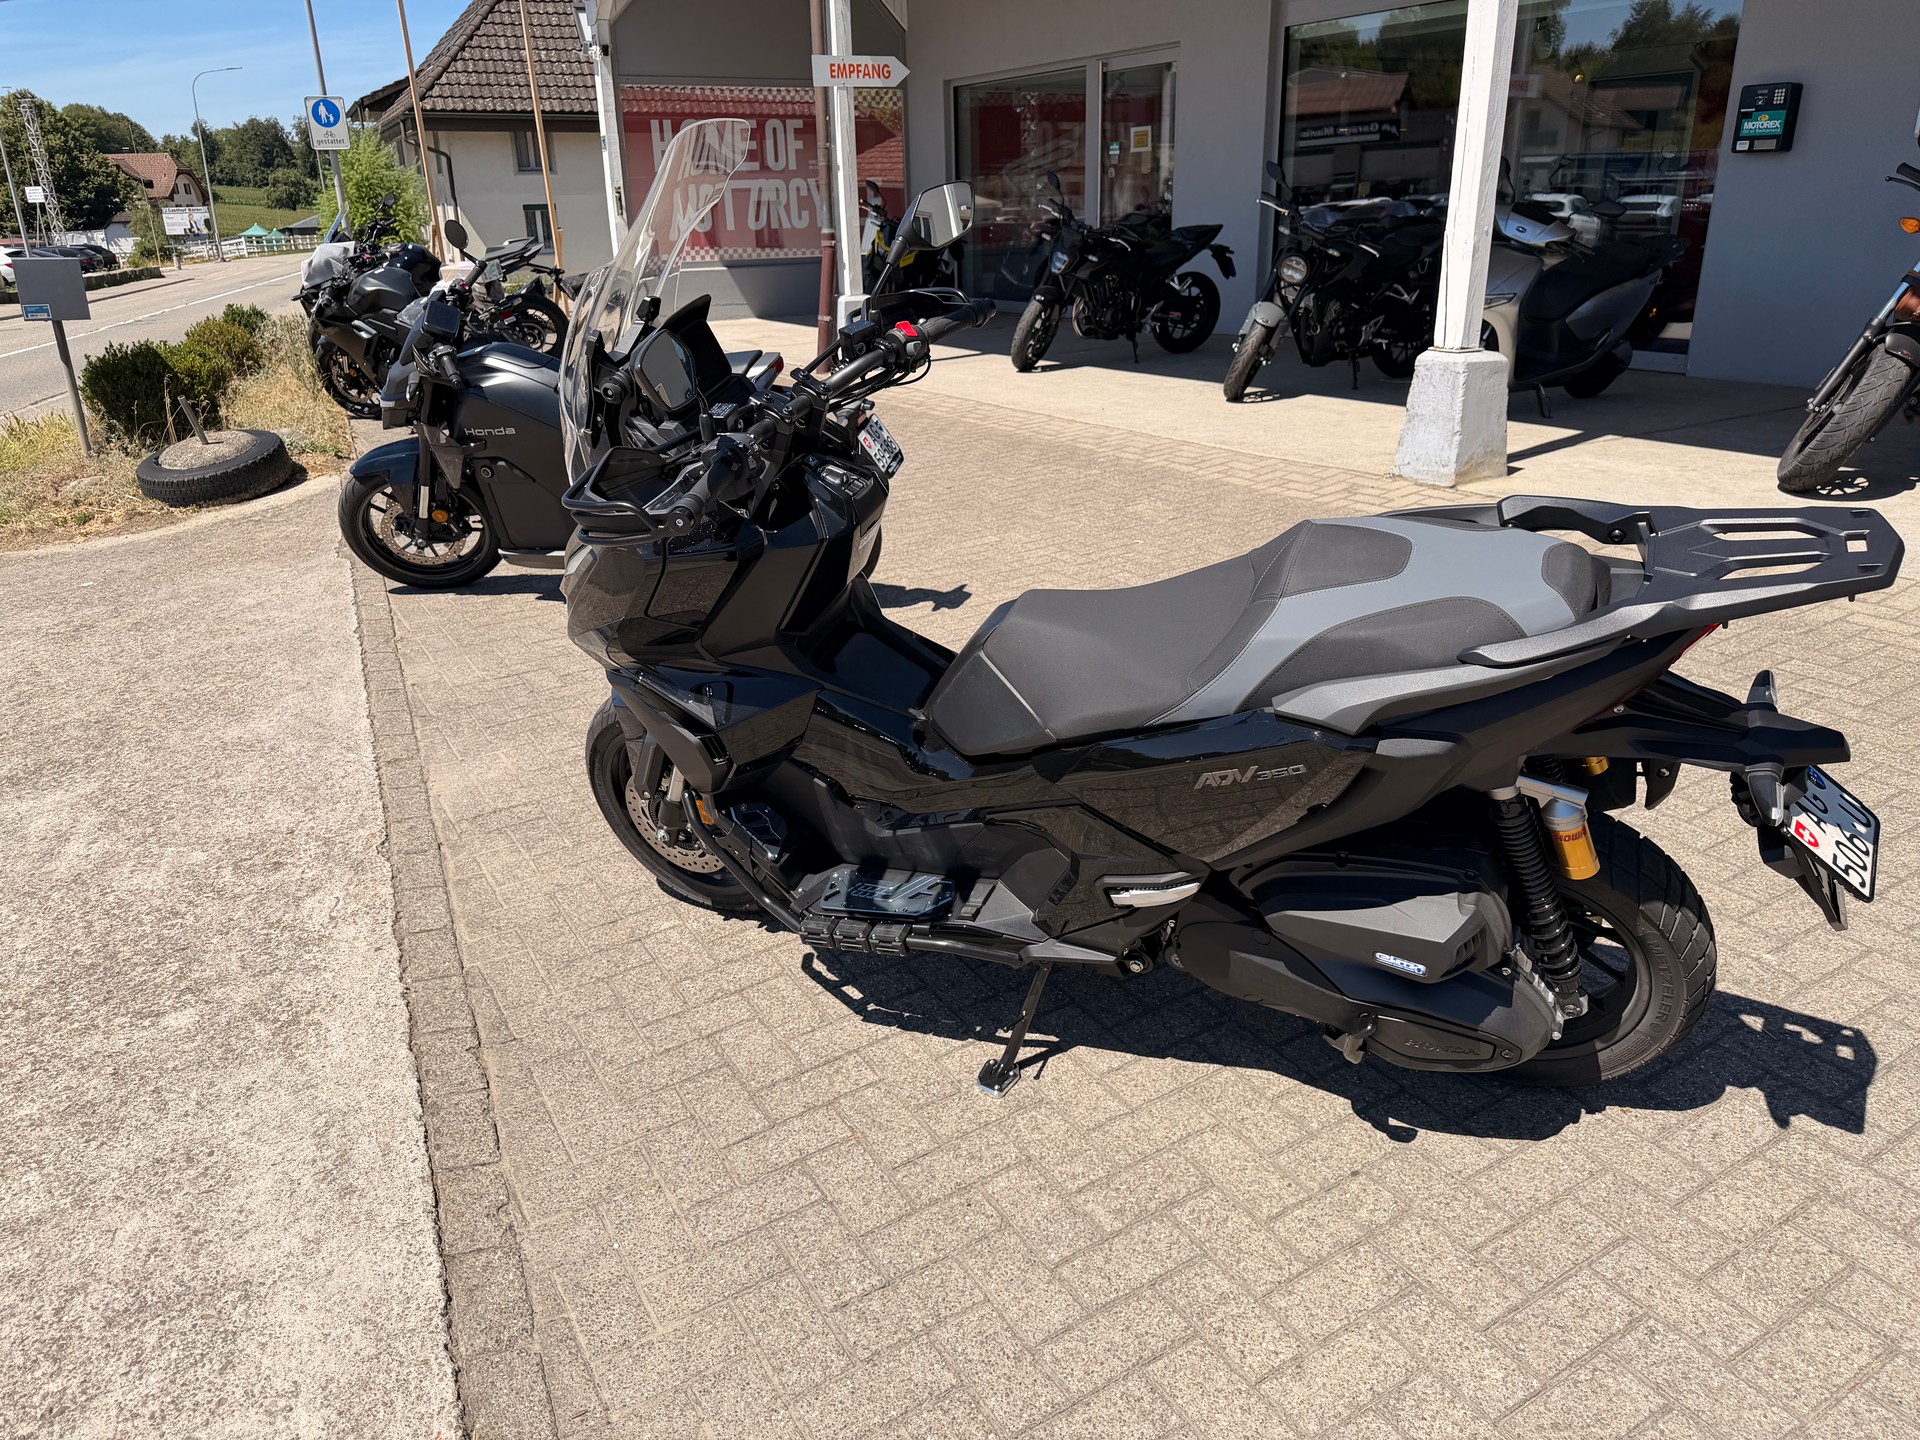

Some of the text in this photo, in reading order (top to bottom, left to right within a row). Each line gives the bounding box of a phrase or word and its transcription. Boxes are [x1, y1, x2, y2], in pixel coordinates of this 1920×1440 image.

[829, 63, 892, 79] EMPFANG
[1743, 120, 1781, 129] MOTOREX
[764, 119, 804, 171] OF
[464, 427, 516, 435] Honda
[866, 424, 881, 446] AG
[1194, 764, 1307, 789] ADV 350
[1795, 793, 1828, 834] AG
[1646, 939, 1675, 1024] METZELER
